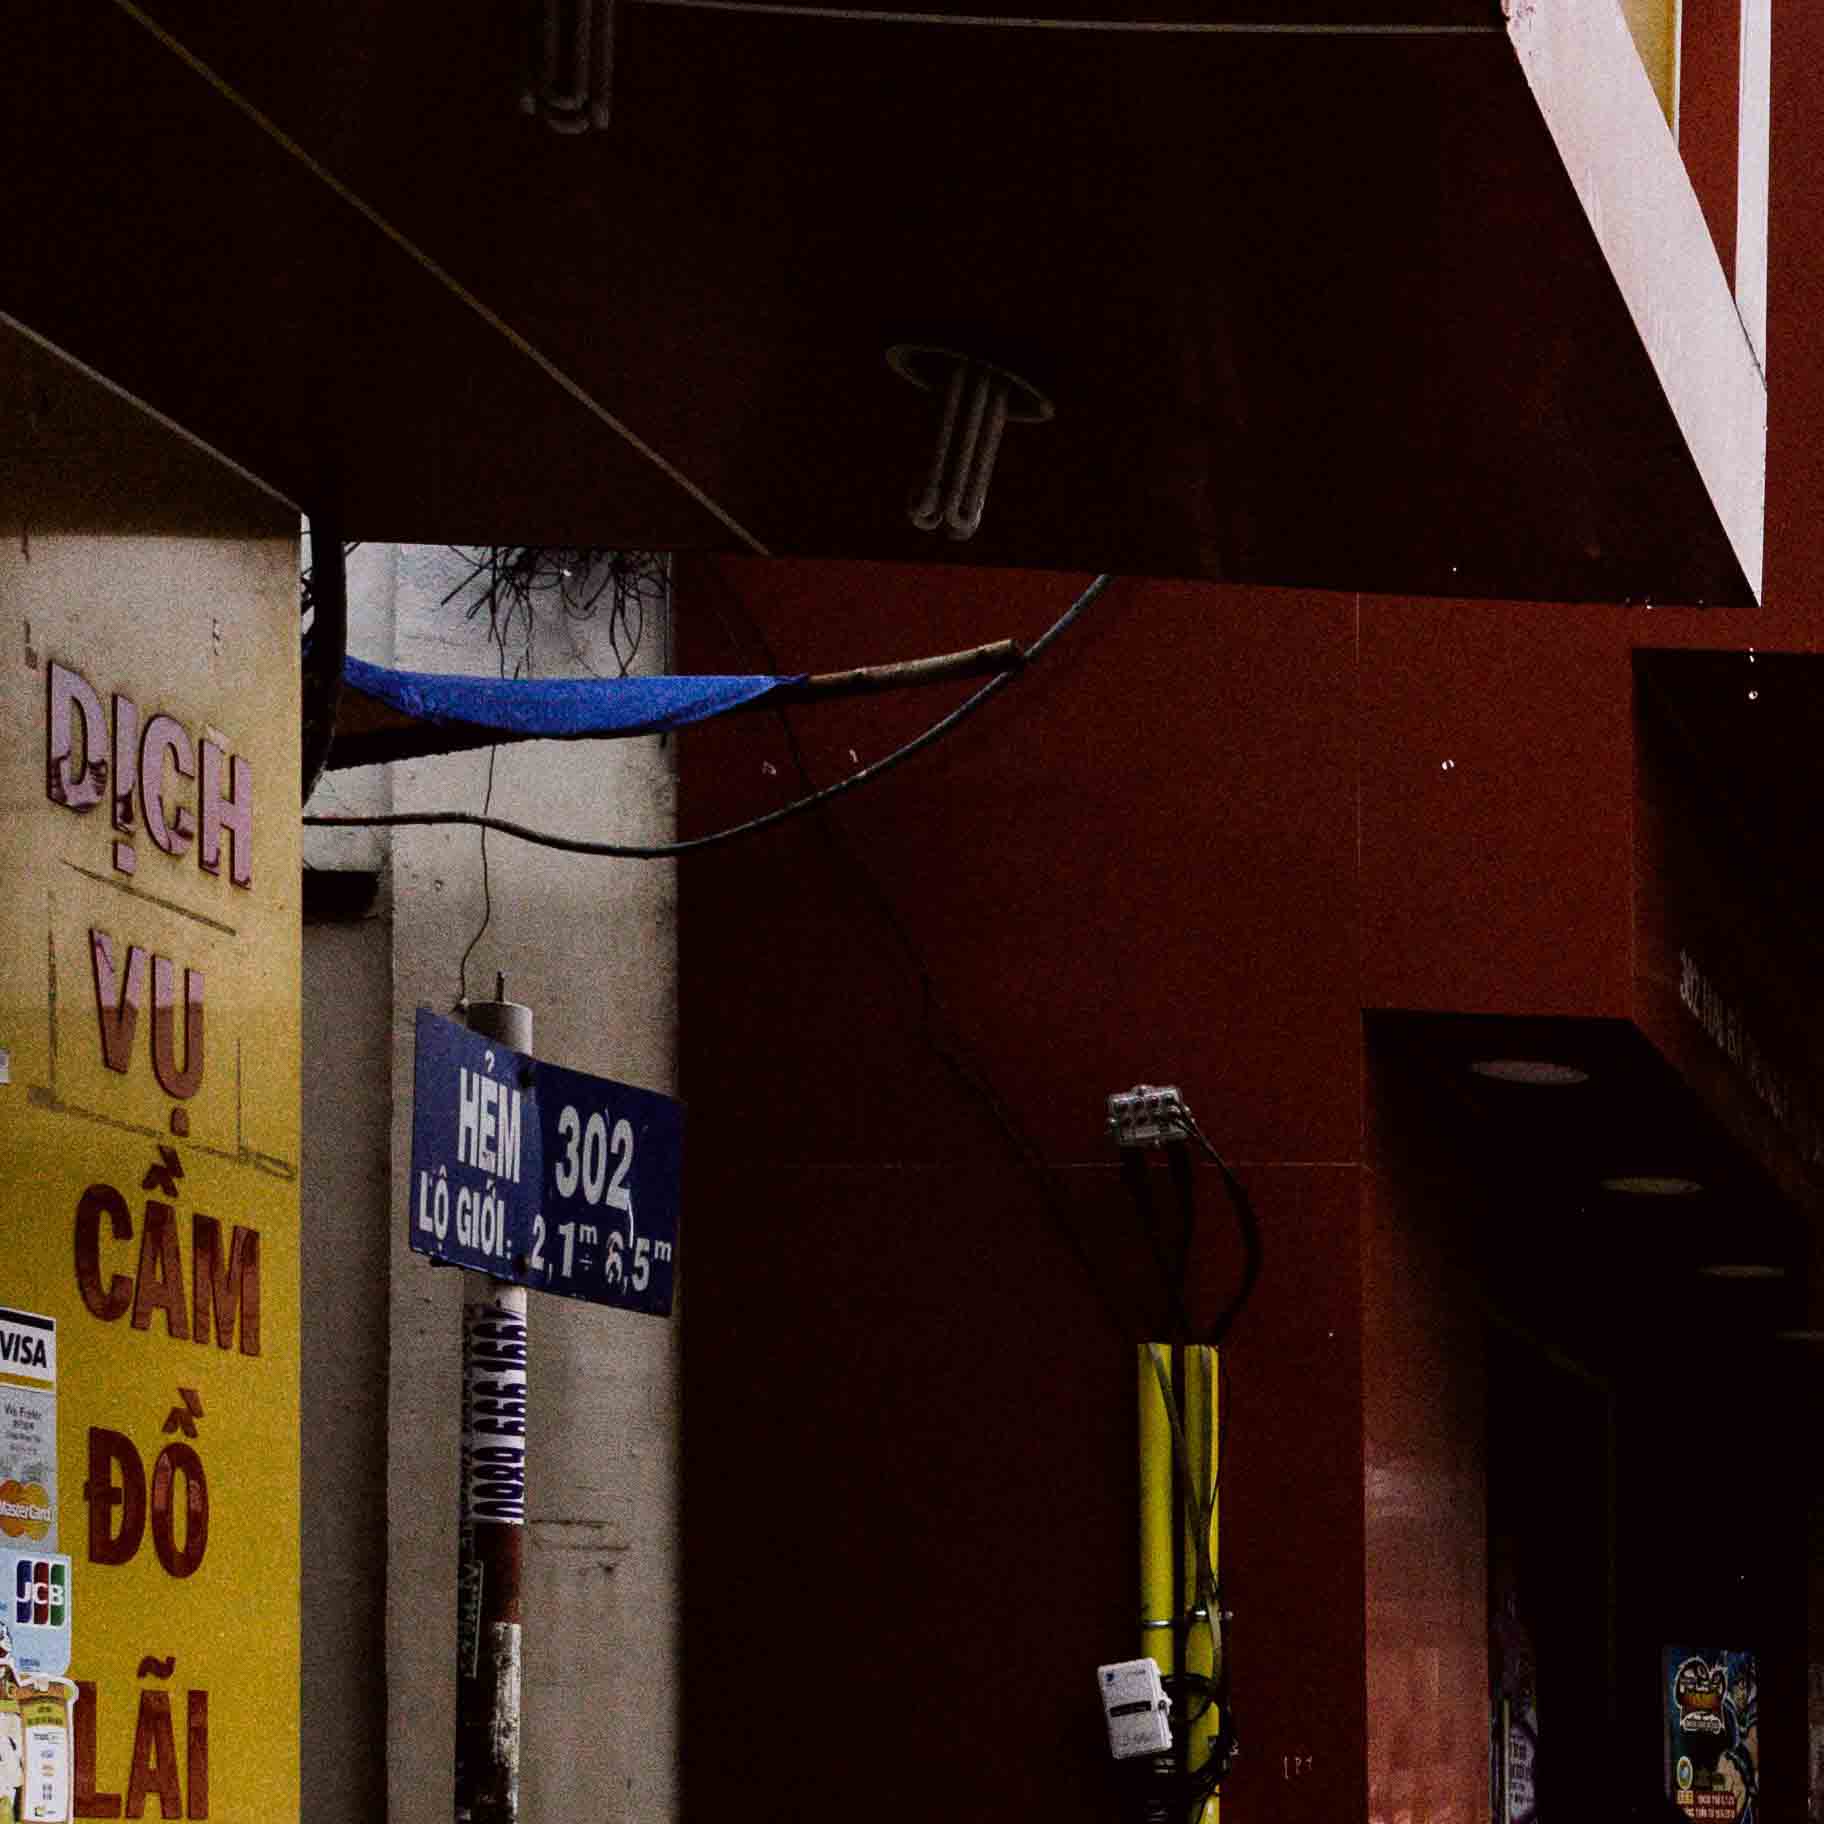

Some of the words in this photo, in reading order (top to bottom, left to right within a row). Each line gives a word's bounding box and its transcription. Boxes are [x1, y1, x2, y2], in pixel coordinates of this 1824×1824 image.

[47, 660, 250, 890] DỊCH
[90, 928, 204, 1137] VỤ
[419, 1165, 449, 1251] LỘ
[458, 1051, 520, 1183] HẺM
[556, 1106, 634, 1210] 302
[75, 1145, 260, 1357] CẦM
[0, 1331, 47, 1368] VISA
[0, 1502, 52, 1522] asterCard
[84, 1388, 209, 1578] ĐỒ
[16, 1581, 66, 1607] JCB
[75, 1655, 209, 1820] LÃI
